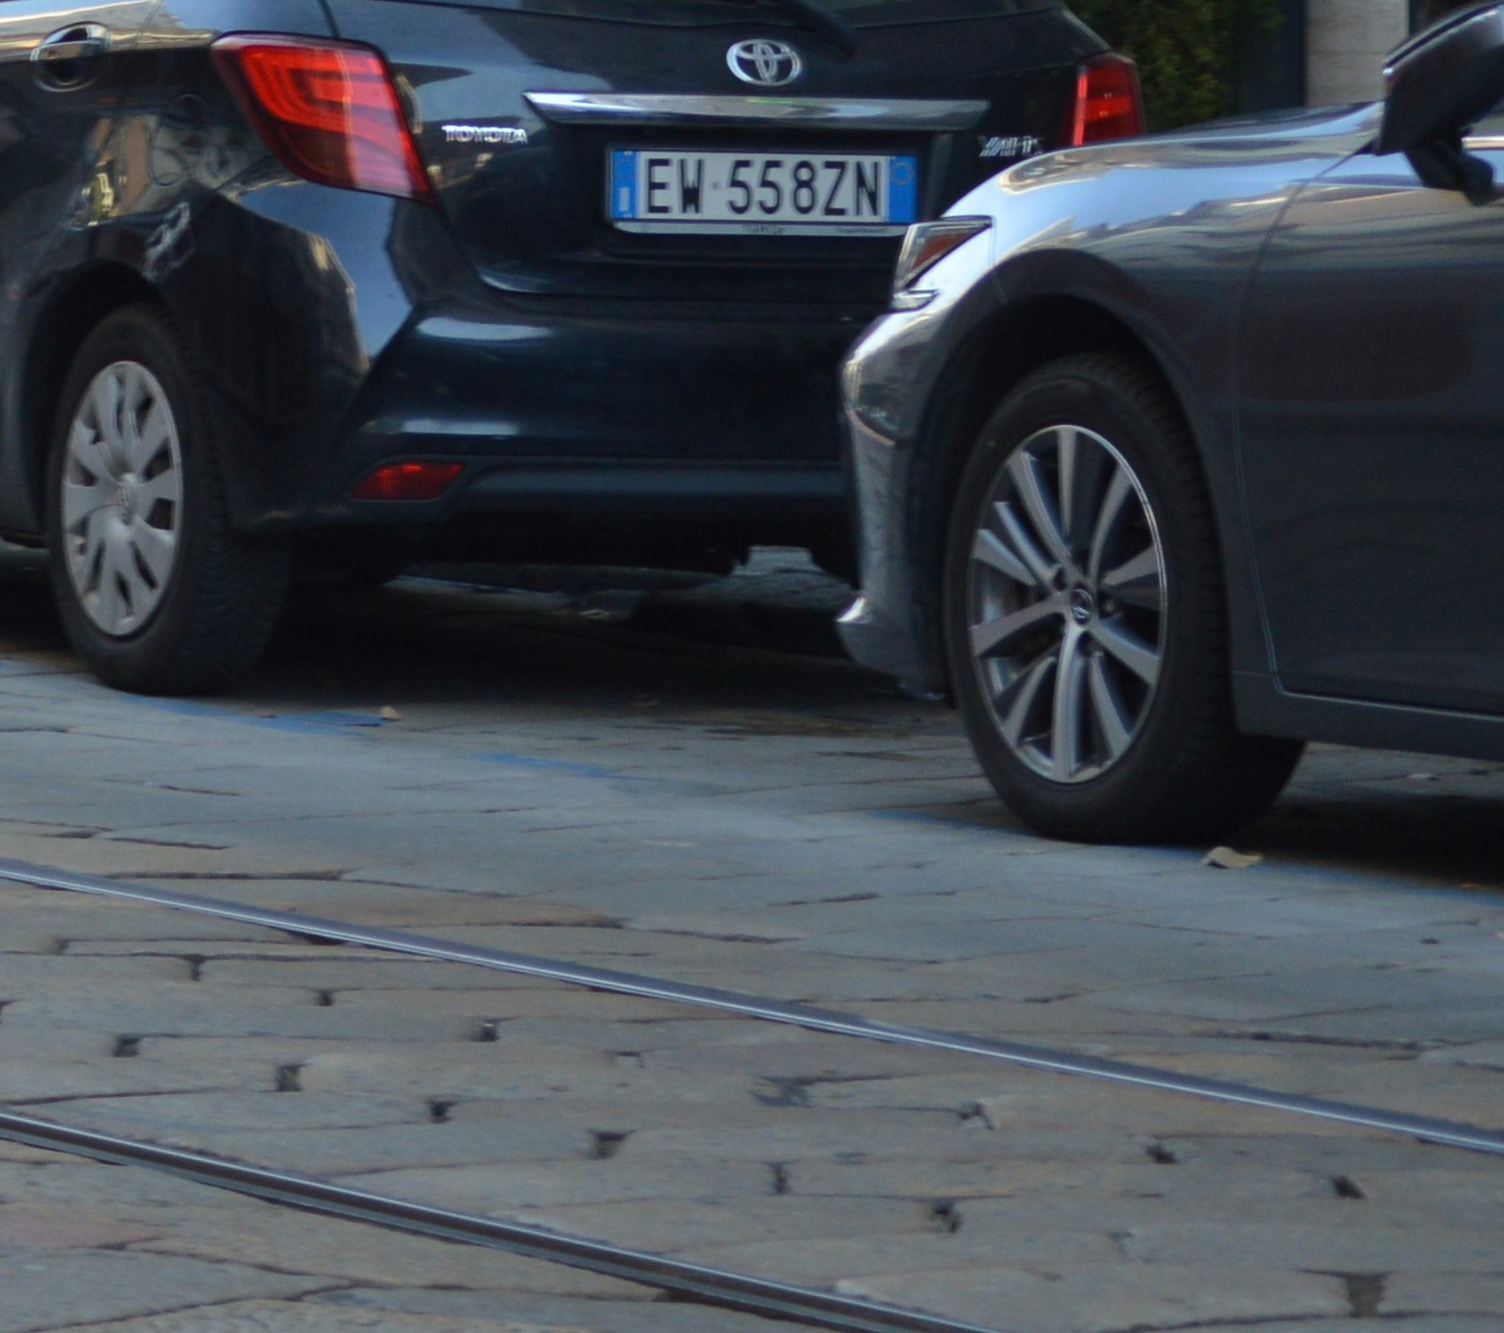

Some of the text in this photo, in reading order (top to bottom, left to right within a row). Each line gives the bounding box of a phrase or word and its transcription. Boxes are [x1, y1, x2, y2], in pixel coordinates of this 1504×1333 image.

[441, 125, 528, 144] TOYOTA
[645, 157, 883, 217] EW 558ZN
